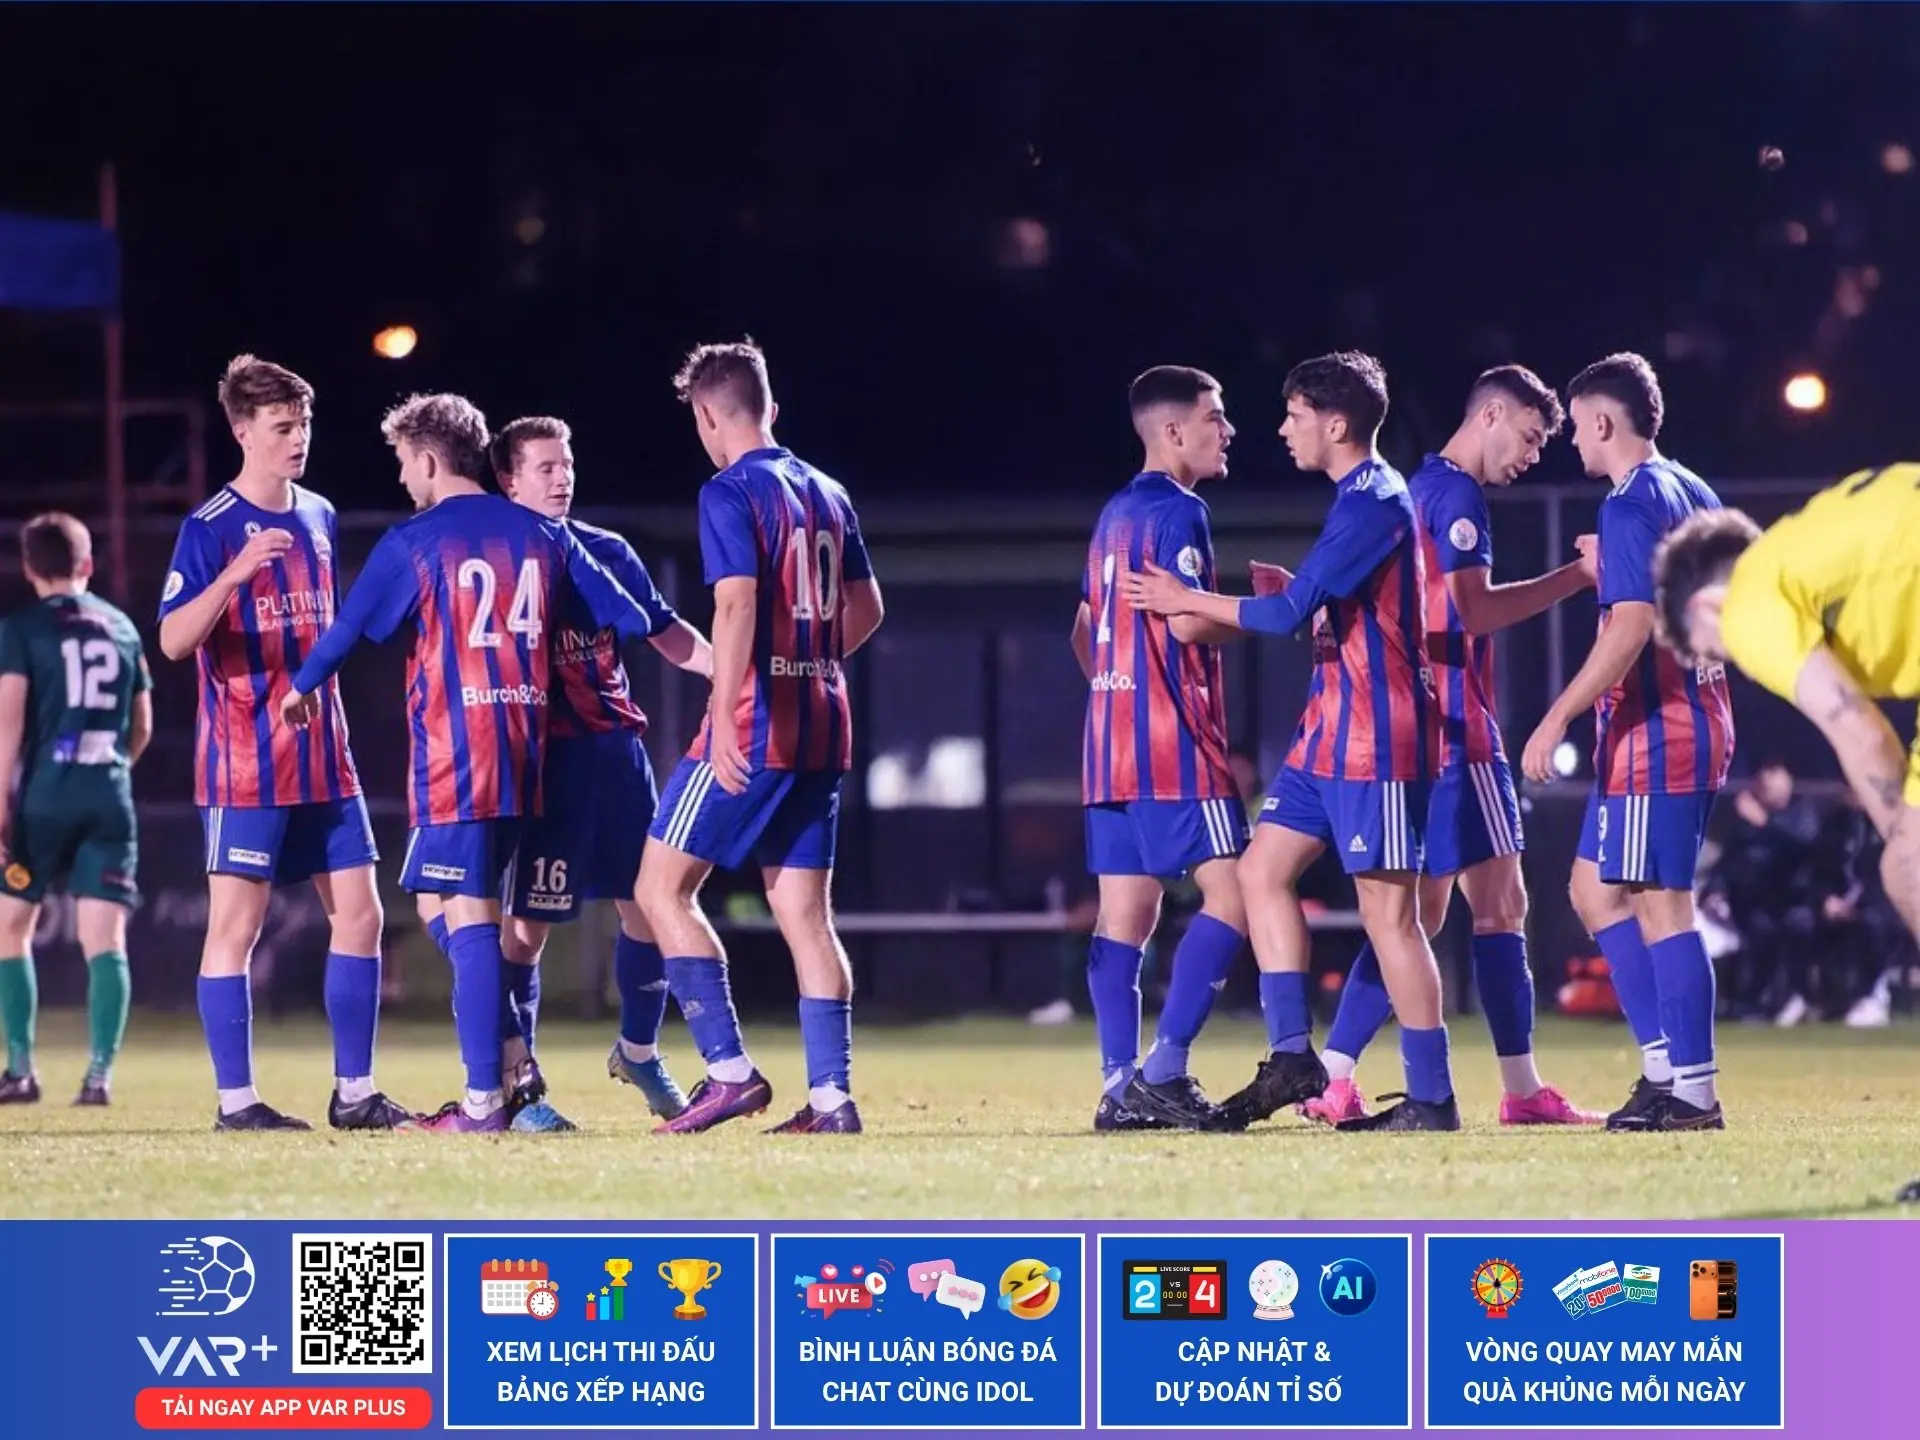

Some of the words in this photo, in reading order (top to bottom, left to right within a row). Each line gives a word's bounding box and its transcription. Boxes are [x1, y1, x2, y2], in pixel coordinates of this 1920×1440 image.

[458, 558, 542, 649] 24
[791, 527, 839, 621] 10
[61, 637, 119, 709] 12
[531, 857, 567, 893] 16
